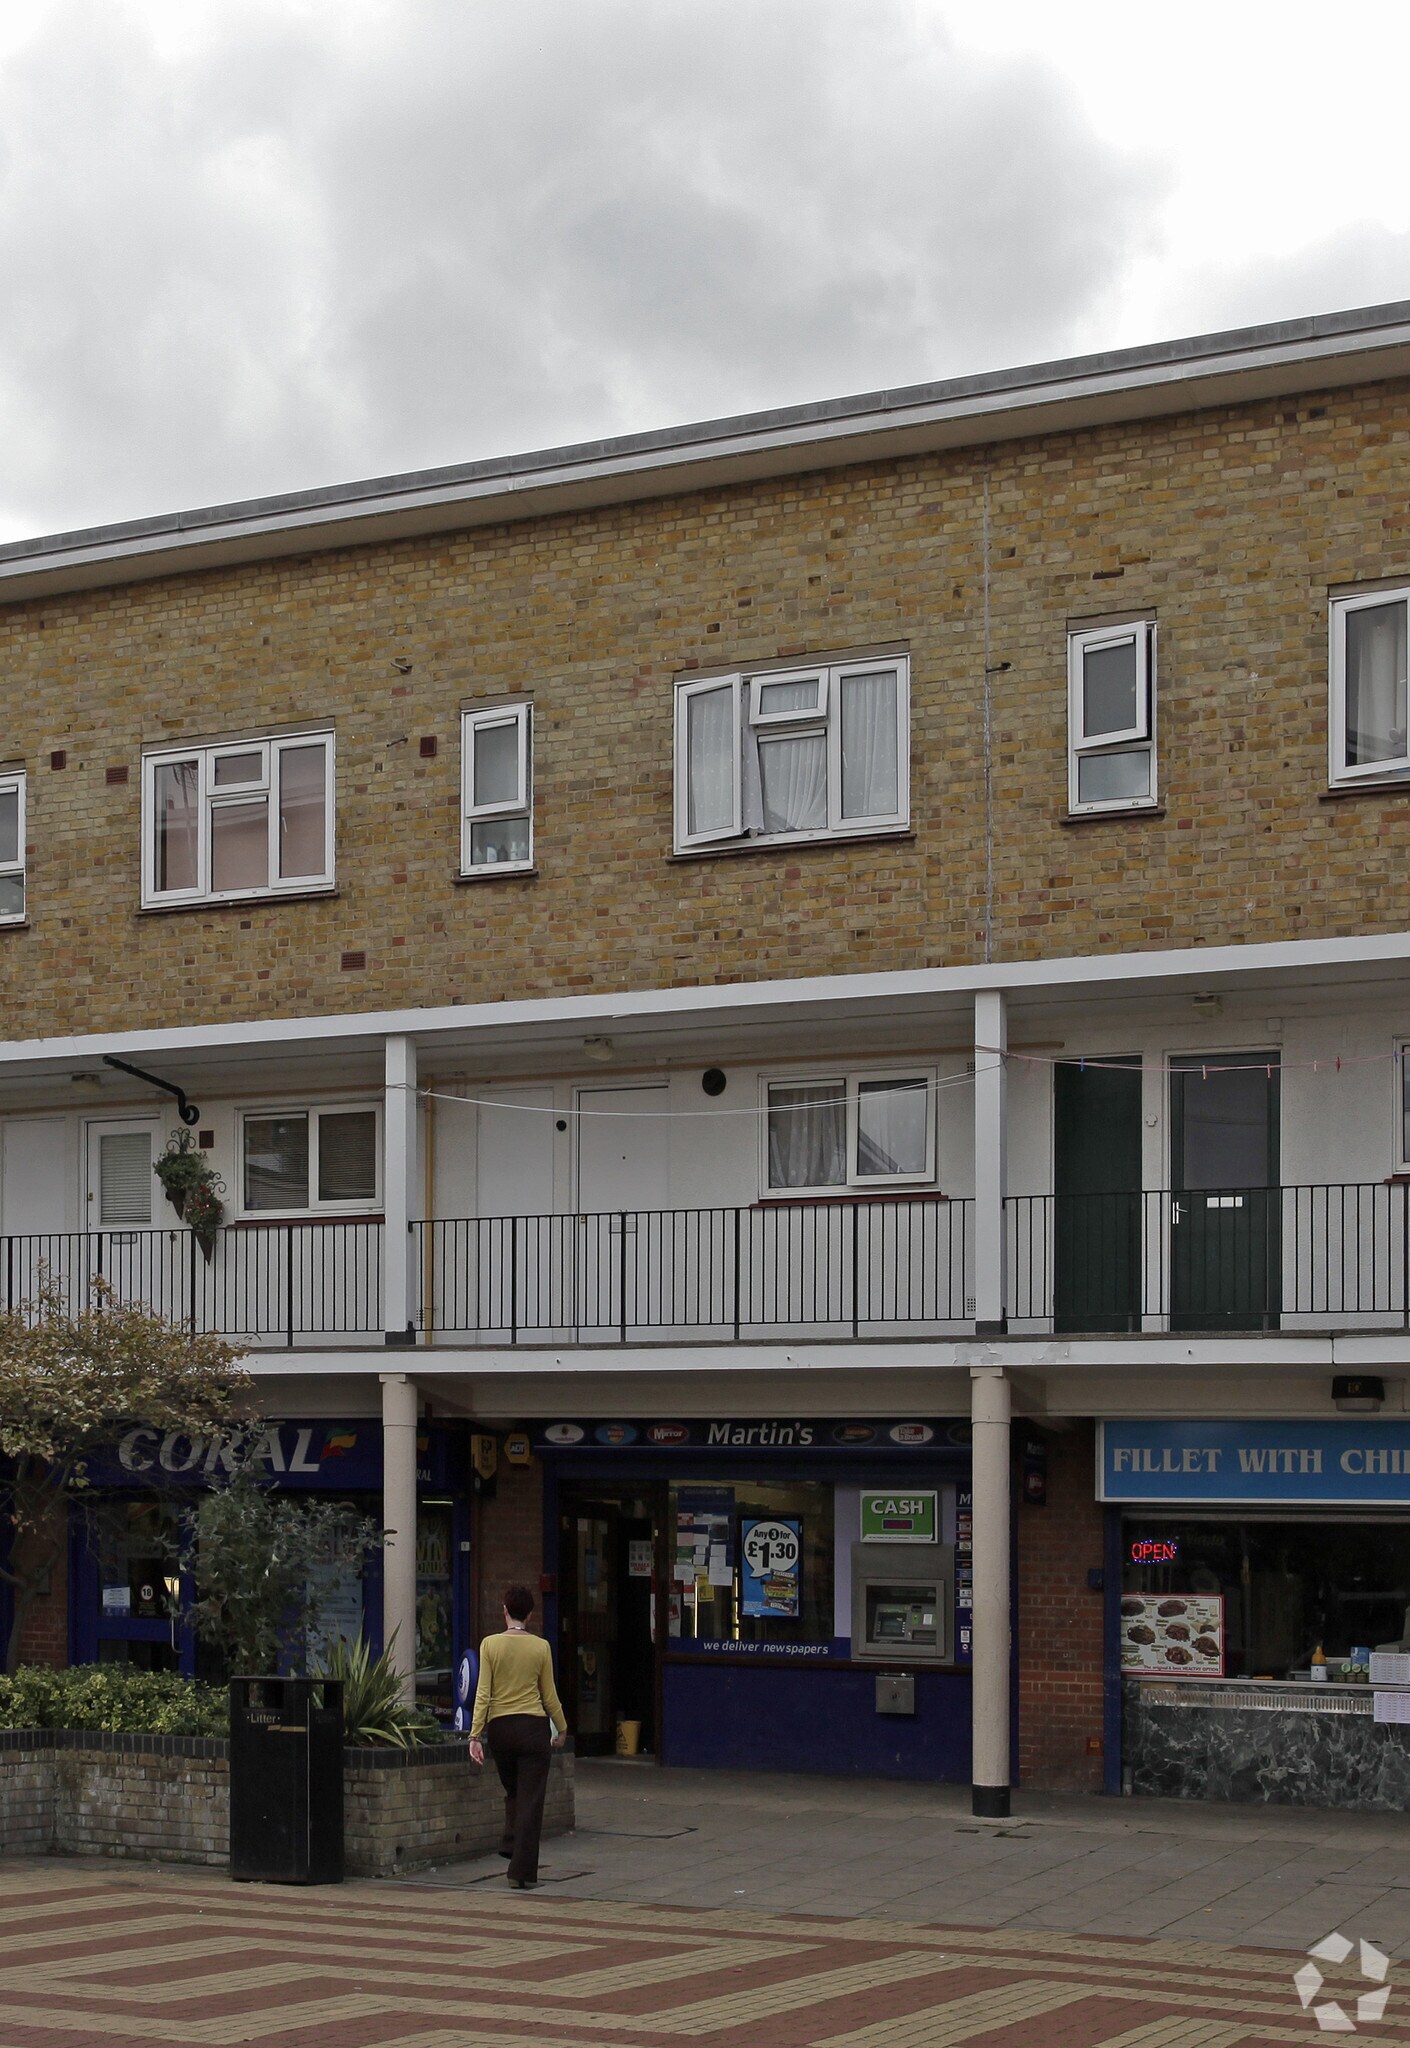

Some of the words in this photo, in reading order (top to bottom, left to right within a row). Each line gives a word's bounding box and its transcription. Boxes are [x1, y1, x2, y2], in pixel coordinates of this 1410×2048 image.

[653, 1428, 683, 1440] Mirror
[707, 1422, 814, 1446] Martin's
[118, 1427, 320, 1473] CORAL
[1113, 1448, 1222, 1473] FILLET
[1237, 1448, 1323, 1474] WITH
[416, 1468, 432, 1481] RAL
[870, 1499, 924, 1515] CASH
[753, 1530, 768, 1540] Any
[779, 1530, 791, 1539] for
[748, 1541, 796, 1568] £1.30
[1131, 1543, 1175, 1560] OPEN
[142, 1588, 152, 1597] 18
[703, 1641, 720, 1651] we
[721, 1640, 760, 1652] deliver
[762, 1643, 829, 1656] newspapers
[250, 1712, 276, 1724] Litter
